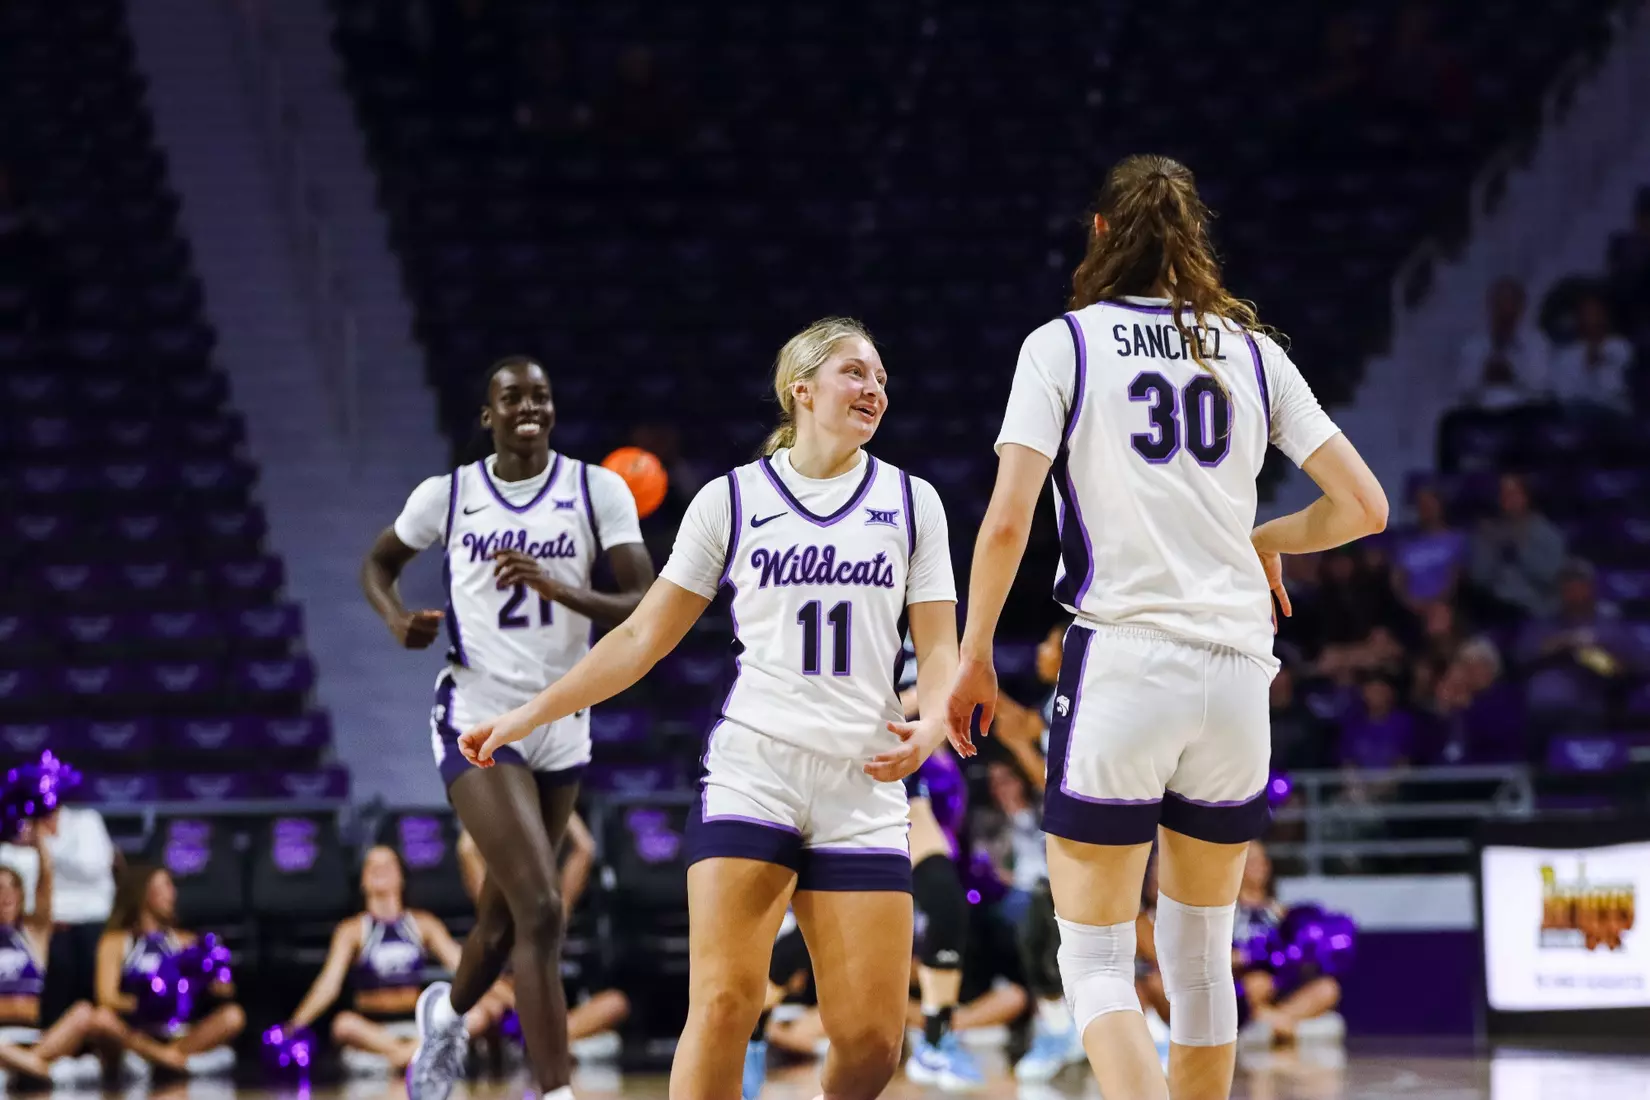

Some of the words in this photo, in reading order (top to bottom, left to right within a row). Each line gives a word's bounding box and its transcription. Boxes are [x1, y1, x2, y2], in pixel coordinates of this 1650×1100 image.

[1112, 323, 1227, 361] SANCHEZ
[1128, 370, 1233, 468] 30
[865, 507, 899, 529] XII
[750, 543, 895, 590] Wildcats
[796, 599, 853, 677] 11
